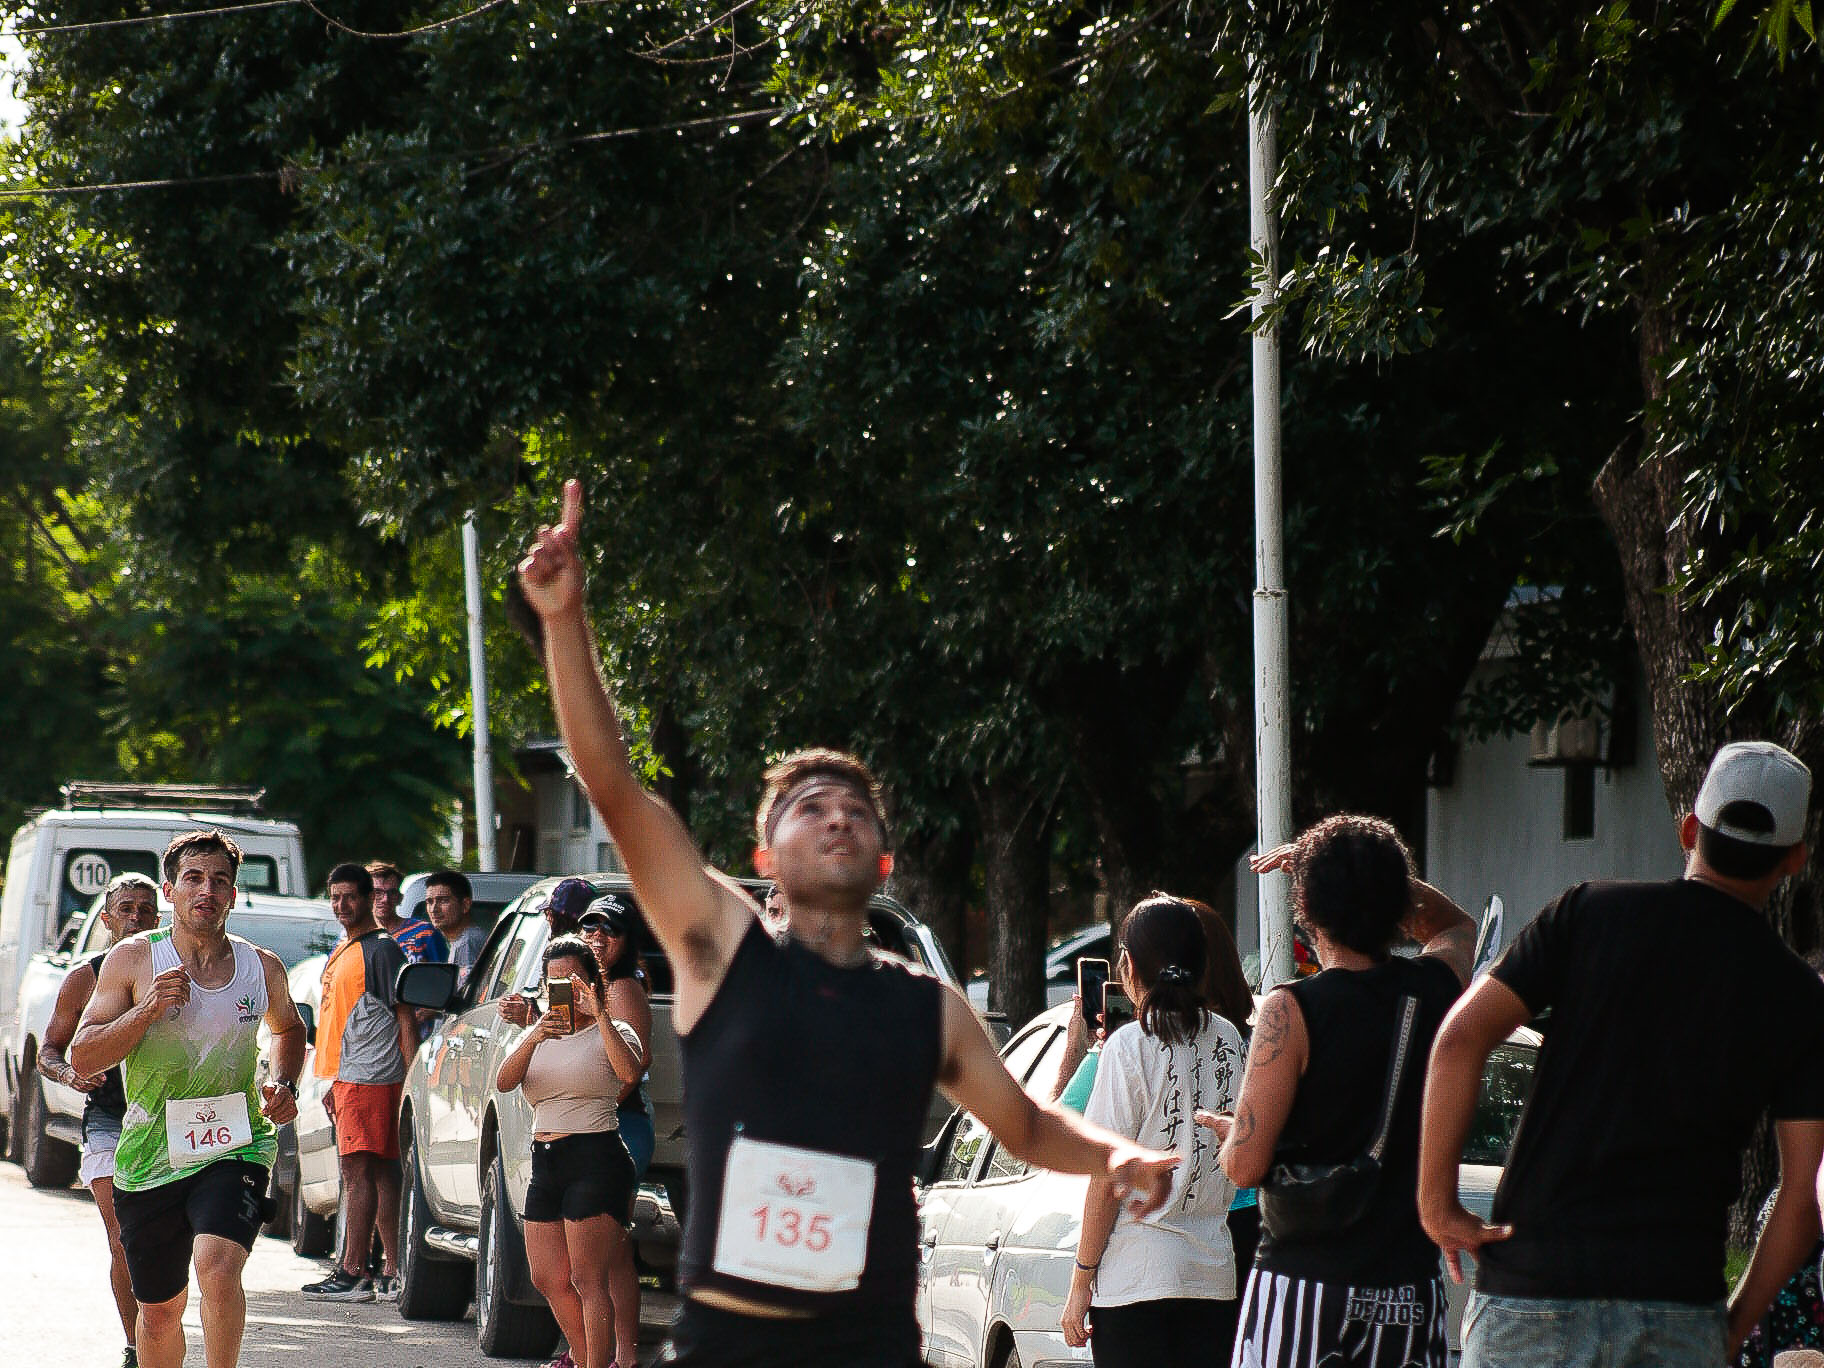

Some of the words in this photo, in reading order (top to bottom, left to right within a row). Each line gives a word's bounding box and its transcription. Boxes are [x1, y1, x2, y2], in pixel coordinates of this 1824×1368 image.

[76, 863, 106, 885] 110
[185, 1127, 232, 1150] 146
[752, 1203, 833, 1253] 135
[1375, 1302, 1425, 1326] DIOS
